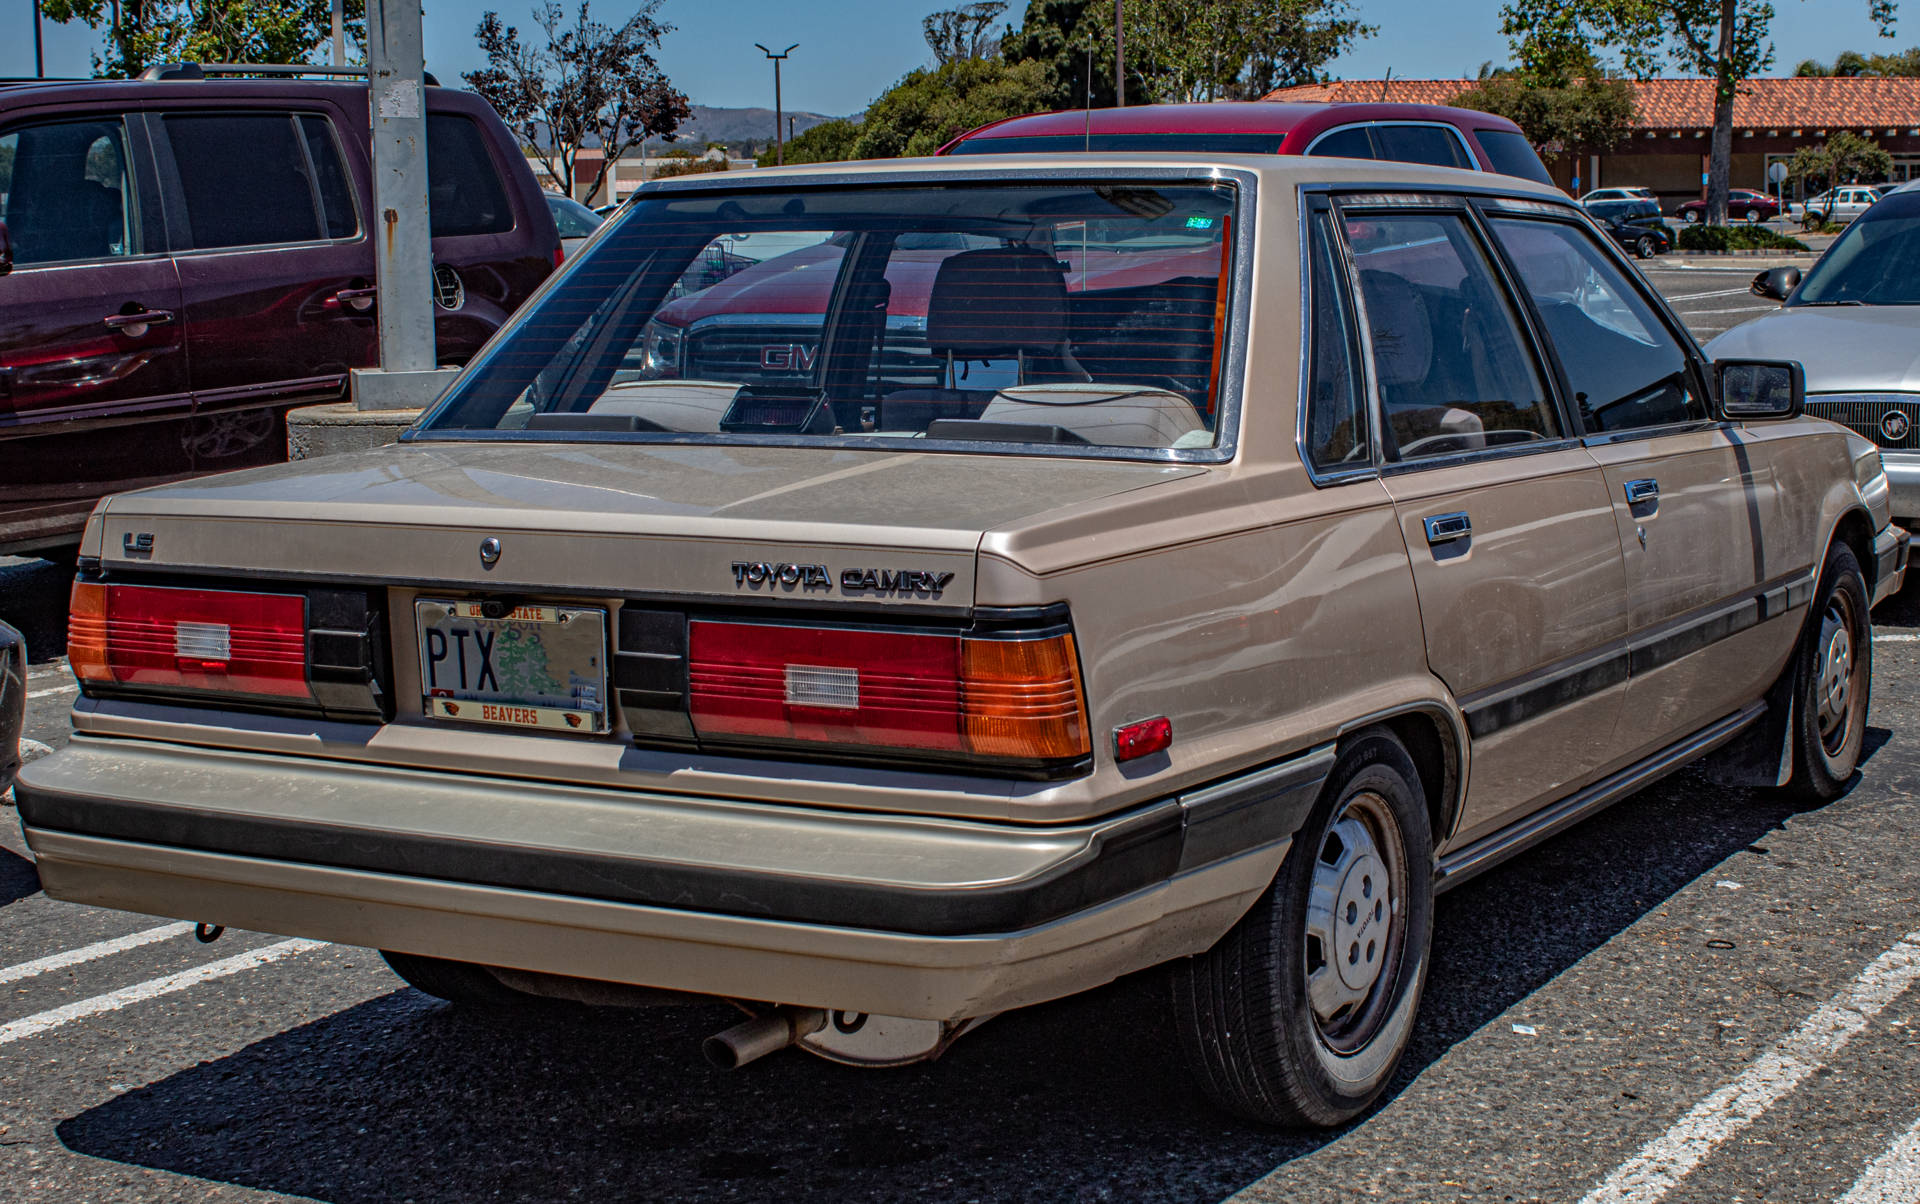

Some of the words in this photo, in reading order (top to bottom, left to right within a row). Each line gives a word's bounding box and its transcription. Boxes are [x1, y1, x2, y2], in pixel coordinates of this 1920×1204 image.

[760, 344, 818, 371] GM
[123, 532, 155, 552] LE
[731, 561, 833, 588] TOYOTA
[840, 568, 955, 593] CAMRY
[511, 606, 542, 620] STATE
[426, 627, 499, 692] PTX
[482, 705, 538, 725] BEAVERS
[1356, 907, 1375, 939] TOYOTA
